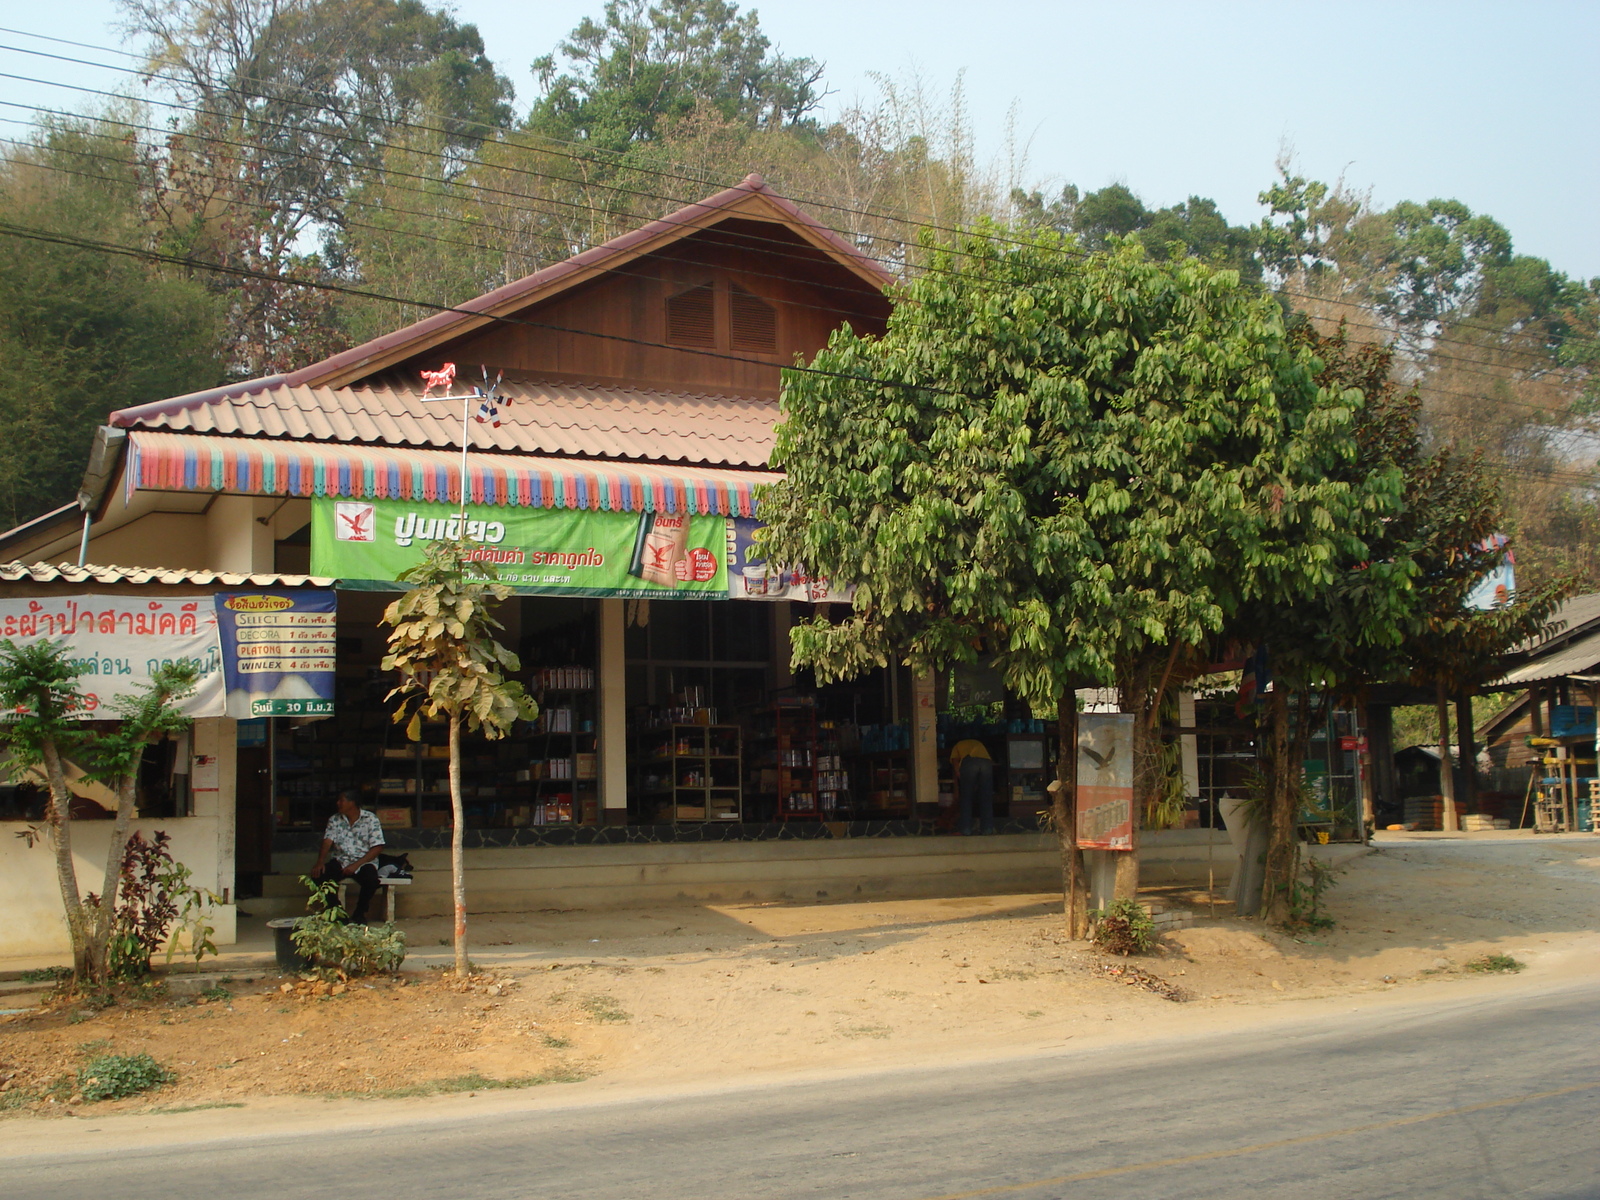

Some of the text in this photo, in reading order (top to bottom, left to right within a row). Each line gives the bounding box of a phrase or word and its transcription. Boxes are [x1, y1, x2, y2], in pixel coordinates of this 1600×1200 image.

[655, 516, 684, 528] อินทรี
[394, 512, 505, 548] ปูนเขียว
[532, 547, 604, 571] ราคาถูกใจ
[0, 600, 199, 636] ะผ้าป่าสามัคคี
[239, 613, 280, 625] SELECT
[240, 630, 280, 641] DECORA
[240, 645, 281, 656] PLATONG
[289, 646, 297, 654] 4
[241, 661, 282, 670] WINLEX
[289, 661, 297, 669] 4
[252, 699, 273, 714] วันนี้
[286, 703, 301, 713] 30
